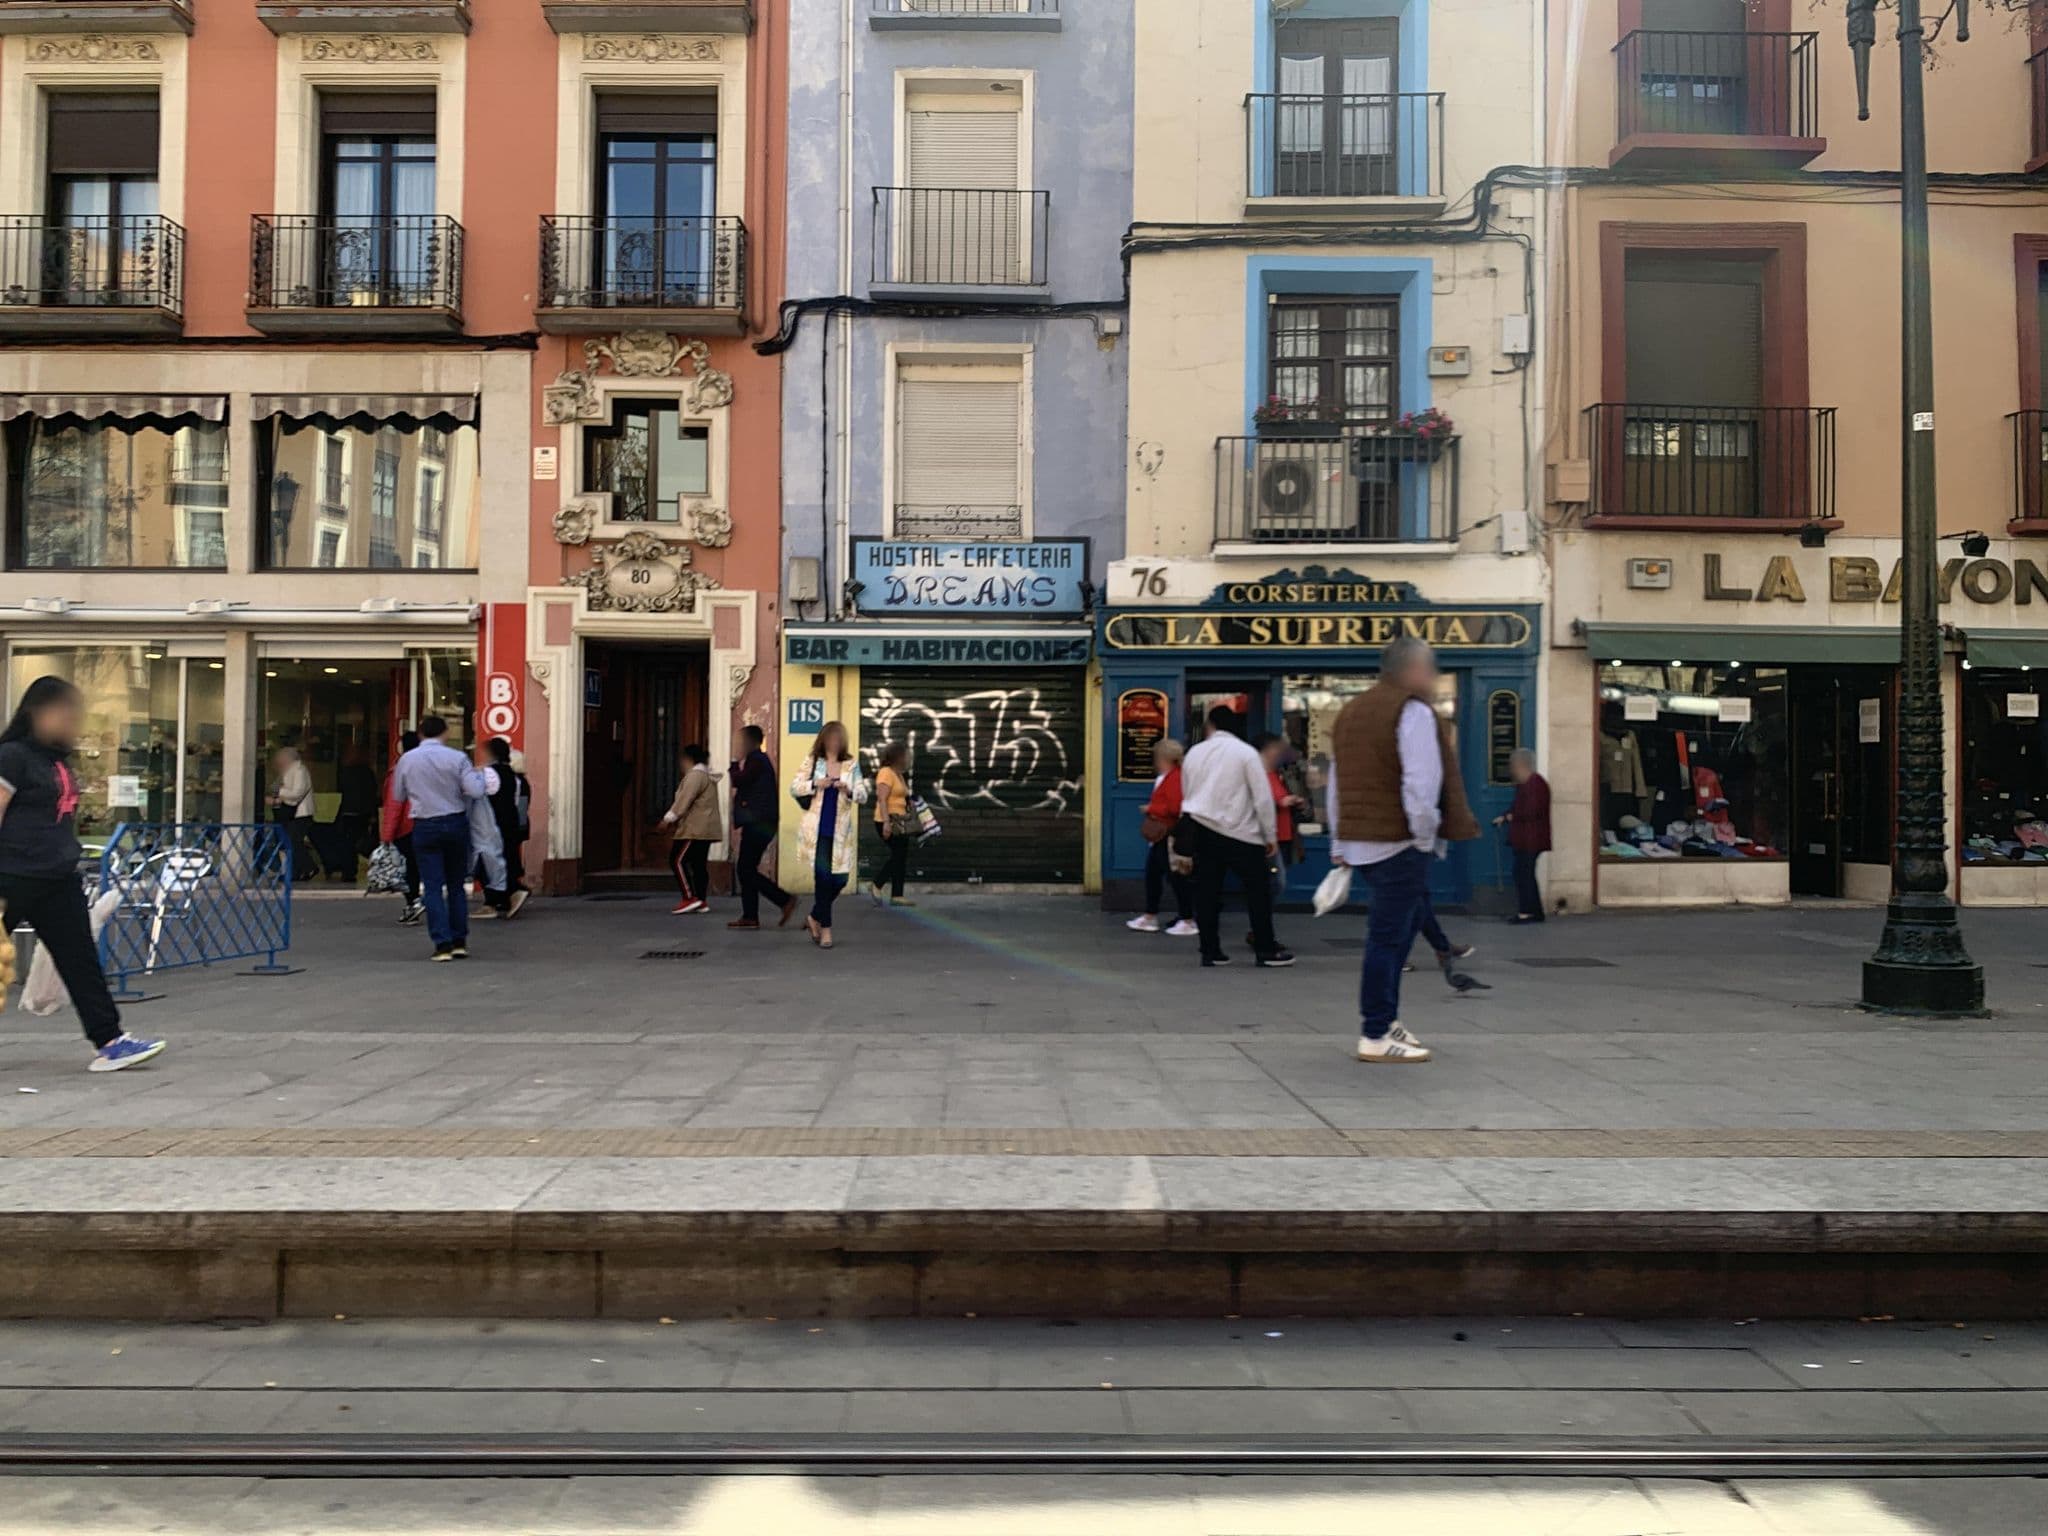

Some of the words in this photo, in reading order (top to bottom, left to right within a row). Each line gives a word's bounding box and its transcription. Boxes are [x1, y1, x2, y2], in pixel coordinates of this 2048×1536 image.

[631, 568, 651, 584] 80
[883, 575, 1057, 606] DREAMS
[1130, 566, 1167, 598] 76
[1703, 553, 1807, 604] LA
[1228, 583, 1401, 603] CORSETERIA
[1164, 617, 1222, 645] LA
[1249, 616, 1472, 645] SUPREMA
[788, 639, 850, 661] BAR
[882, 639, 1088, 661] HABITACIONES
